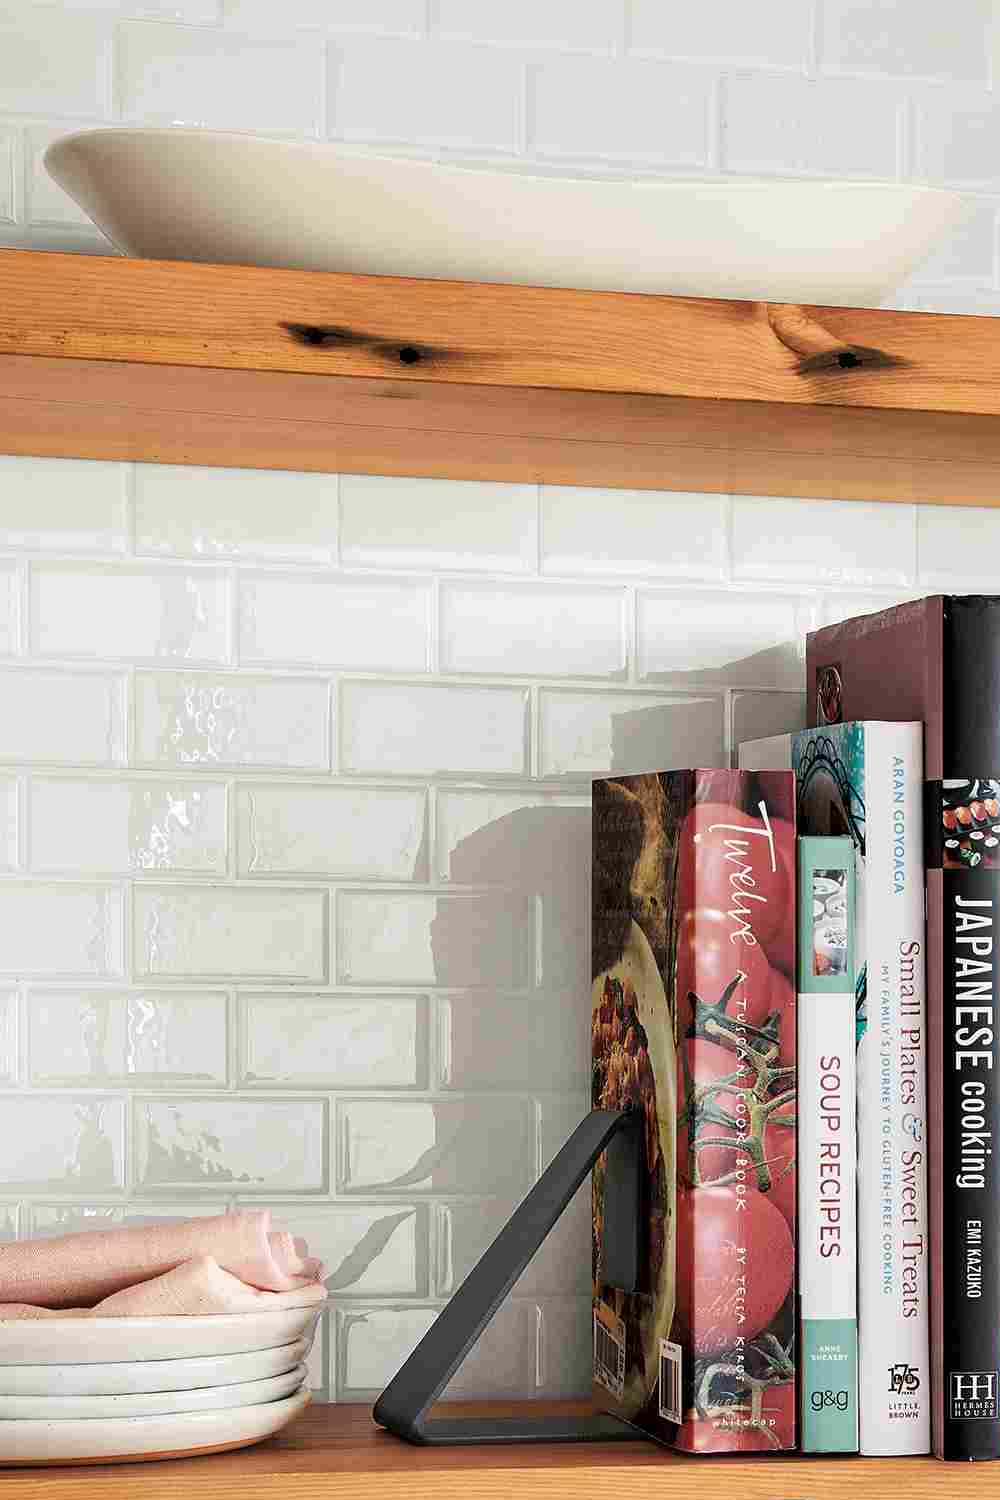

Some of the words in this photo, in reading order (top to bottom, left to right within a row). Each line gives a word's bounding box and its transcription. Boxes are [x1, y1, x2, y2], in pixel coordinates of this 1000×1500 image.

[893, 755, 905, 804] ARAN
[708, 799, 776, 945] Twelve
[893, 809, 905, 896] GOYOAGA
[880, 966, 890, 984] MY
[899, 941, 921, 1016] Small
[955, 895, 994, 1070] JAPANESE
[880, 991, 890, 1047] FAMILY'S
[819, 1056, 841, 1131] SOUP
[880, 1051, 890, 1112] JOURNEY
[900, 1026, 921, 1105] Plates
[736, 1093, 748, 1144] COOK
[881, 1118, 891, 1135] TO
[902, 1112, 922, 1143] &
[956, 1081, 993, 1189] cooking
[736, 1159, 748, 1212] BOOK
[819, 1143, 841, 1258] RECIPES
[881, 1140, 892, 1227] GLUTEN-FREE
[901, 1151, 922, 1225] Sweet
[966, 1219, 982, 1244] EMI
[882, 1234, 893, 1294] COOKING
[902, 1234, 928, 1319] Treats
[966, 1250, 982, 1299] KAZUKO
[811, 1390, 849, 1411] g&g
[888, 1411, 919, 1419] BROWN
[954, 1401, 996, 1409] HERMES
[954, 1409, 996, 1417] HOUSE
